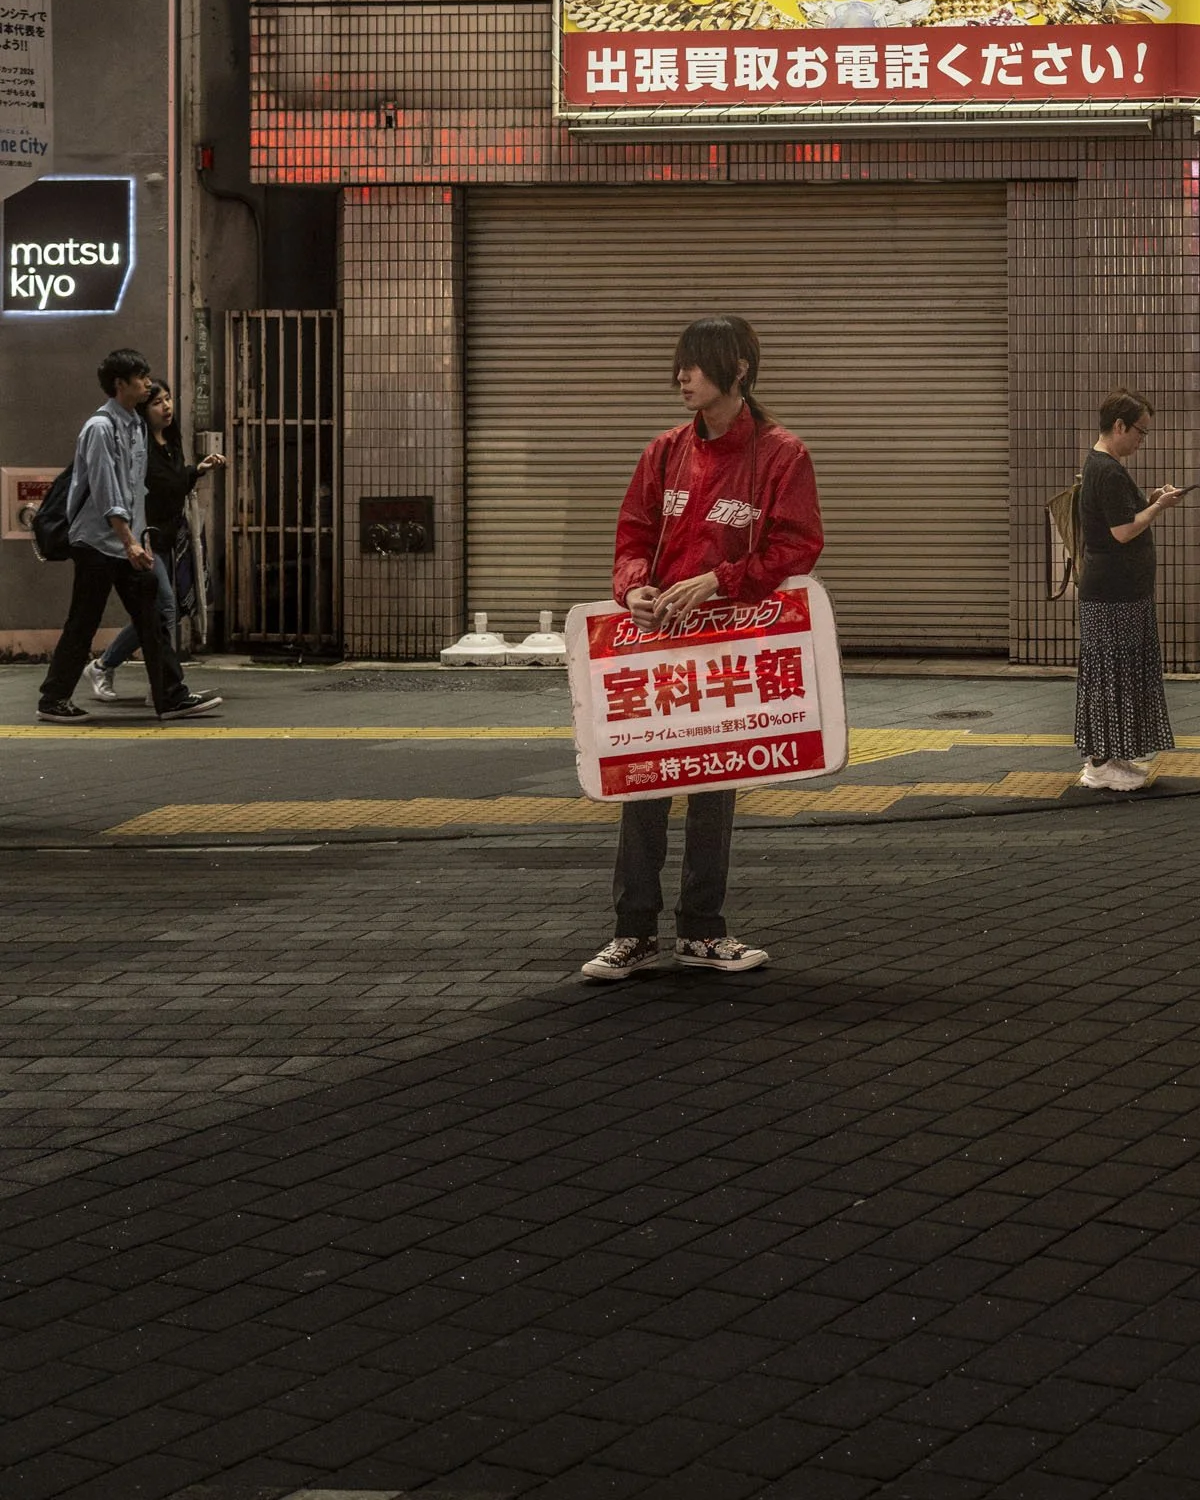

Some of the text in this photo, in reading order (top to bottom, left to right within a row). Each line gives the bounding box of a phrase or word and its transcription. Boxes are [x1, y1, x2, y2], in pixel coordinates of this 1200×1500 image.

[0, 40, 28, 52] よう!!
[586, 41, 1148, 94] 出張買取お電話ください!
[10, 237, 120, 267] matsu
[10, 267, 76, 311] kiyo
[602, 646, 806, 723] 室料半額
[660, 740, 799, 783] 持ち込みOK!
